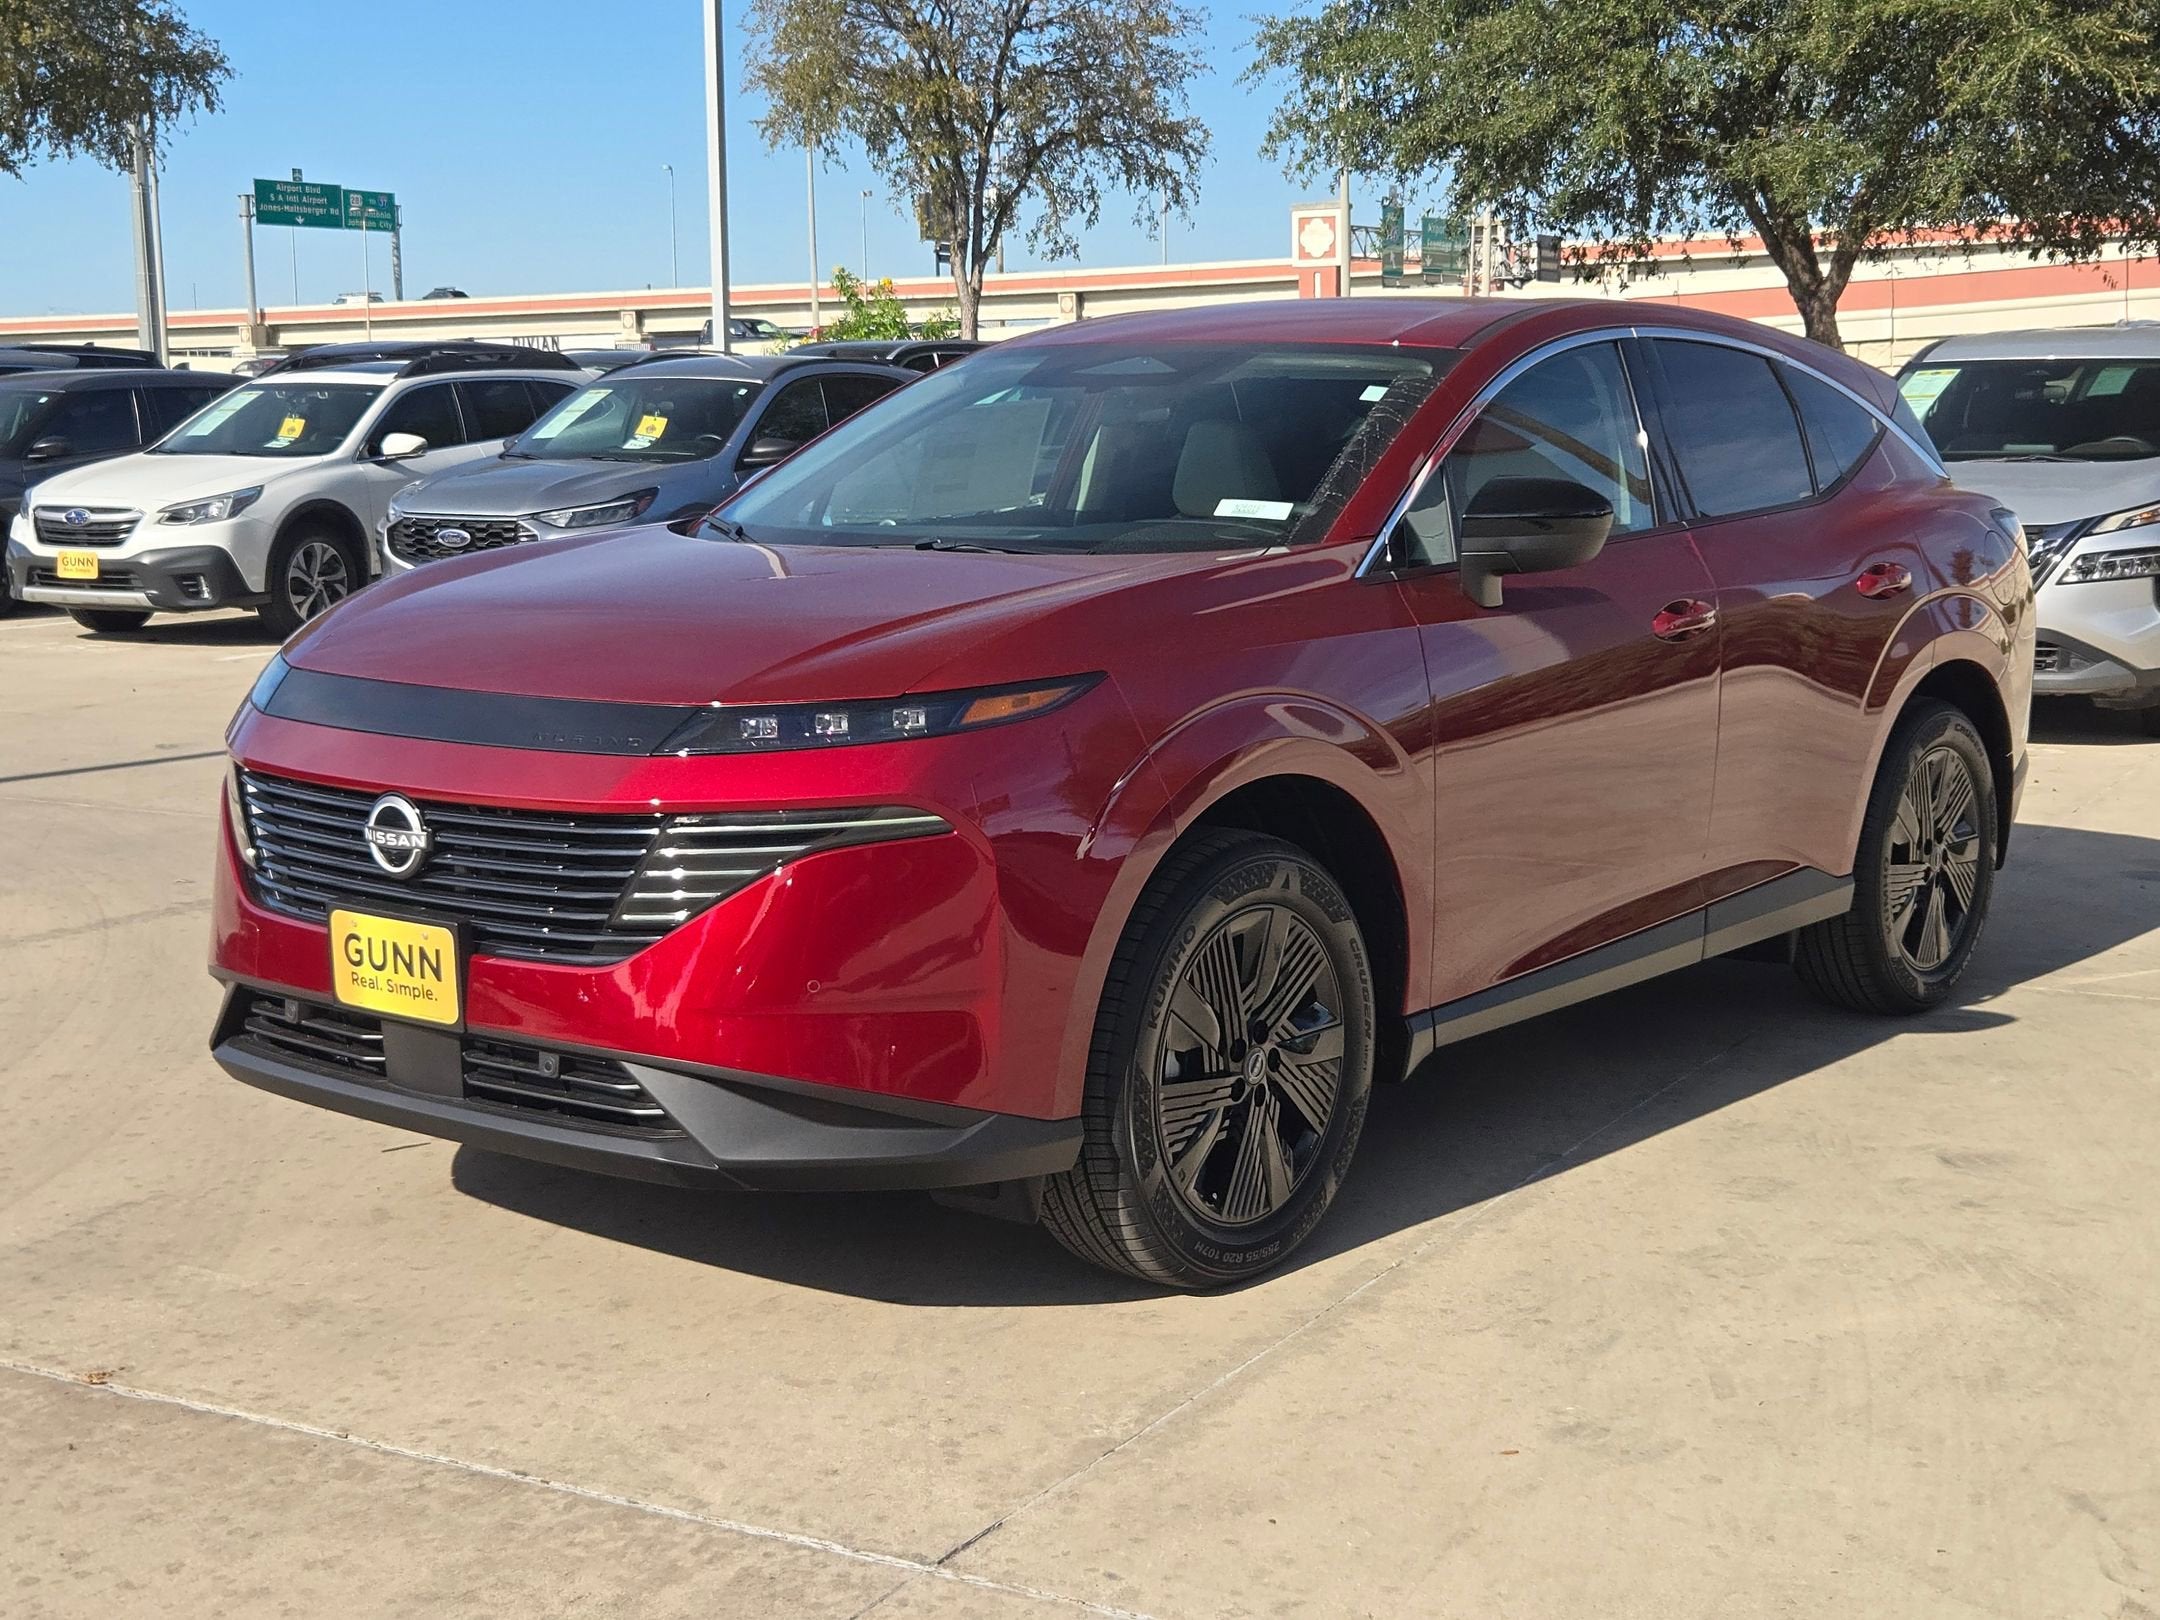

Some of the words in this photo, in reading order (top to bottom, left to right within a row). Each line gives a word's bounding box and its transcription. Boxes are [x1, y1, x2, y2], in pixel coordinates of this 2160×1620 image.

[276, 183, 302, 193] Airport
[305, 185, 321, 194] Blvd
[279, 194, 284, 202] A
[302, 195, 328, 205] Airport
[330, 208, 340, 216] Rd
[61, 556, 94, 567] GUNN
[365, 827, 427, 849] NISSAN
[344, 932, 443, 982] GUNN
[1147, 925, 1196, 1030] KUMHO
[351, 971, 383, 991] Real.
[387, 978, 438, 1001] Simple.
[1222, 1252, 1244, 1264] R20
